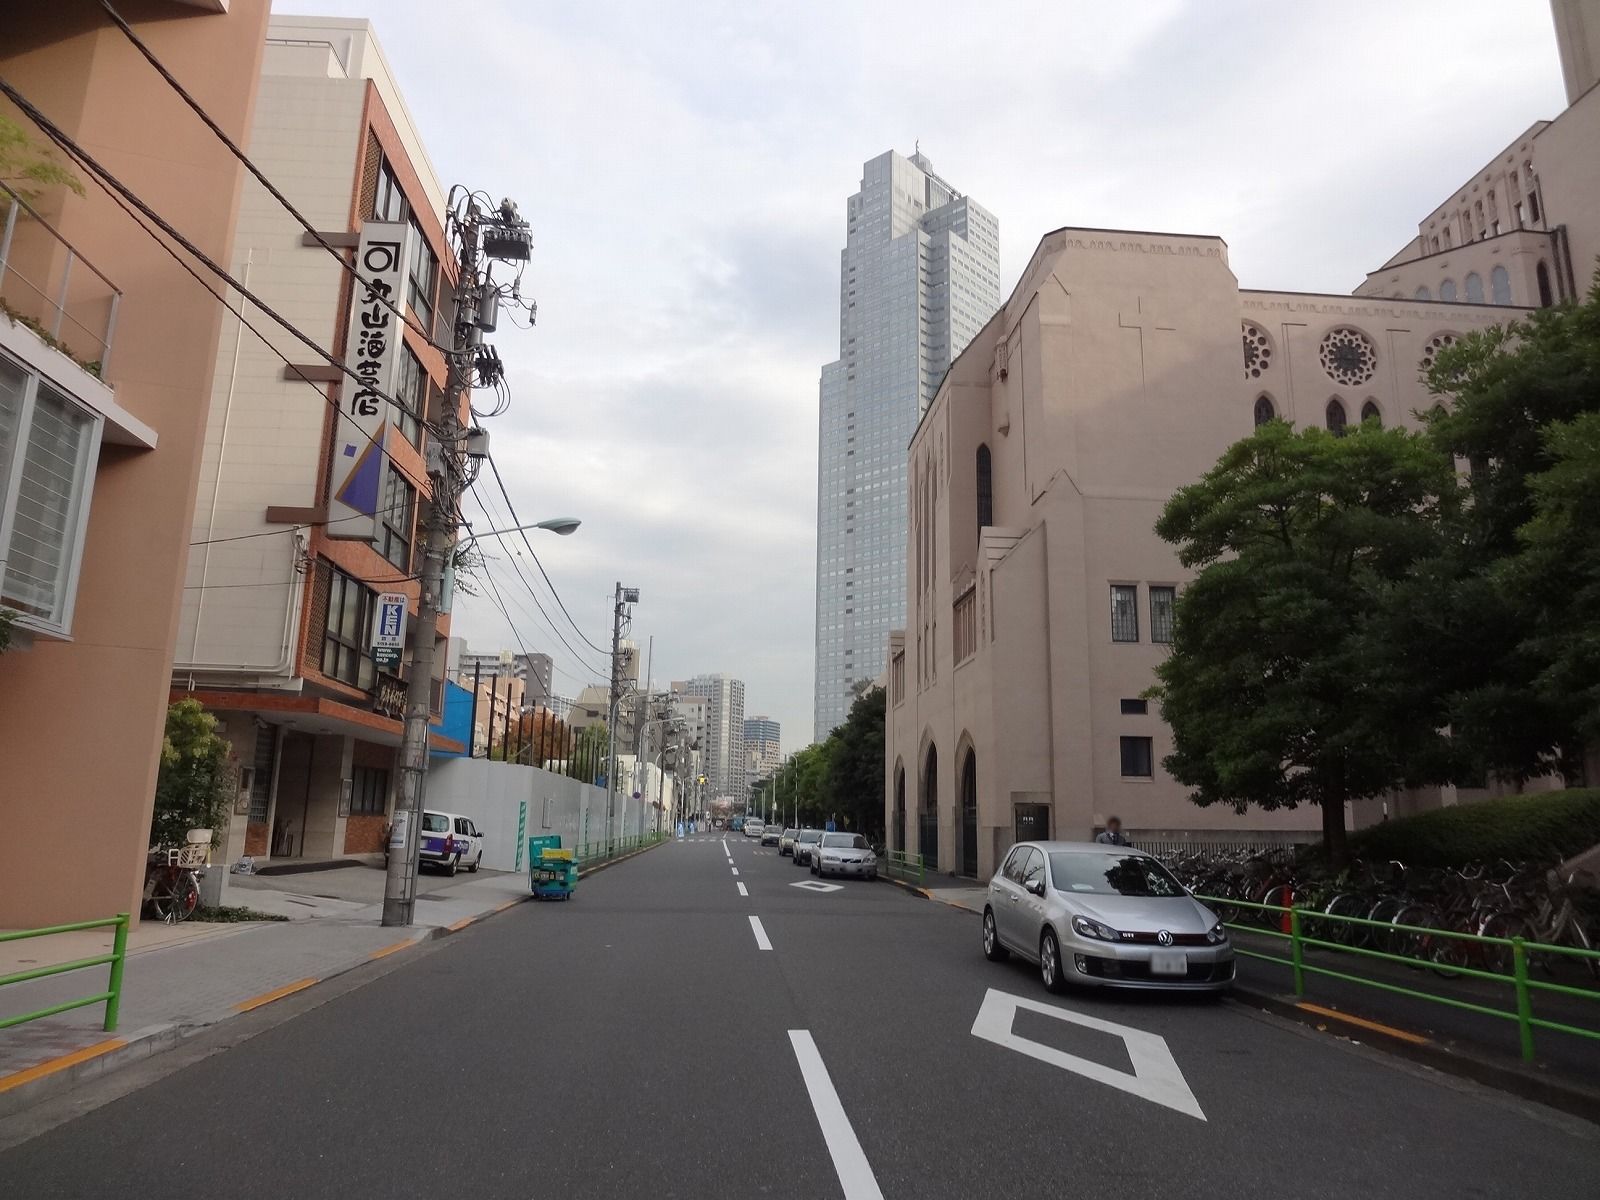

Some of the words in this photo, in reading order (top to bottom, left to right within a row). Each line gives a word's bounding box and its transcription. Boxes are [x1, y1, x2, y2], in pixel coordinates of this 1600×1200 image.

[351, 278, 395, 416] 丸山海苔店
[384, 605, 399, 635] KEN
